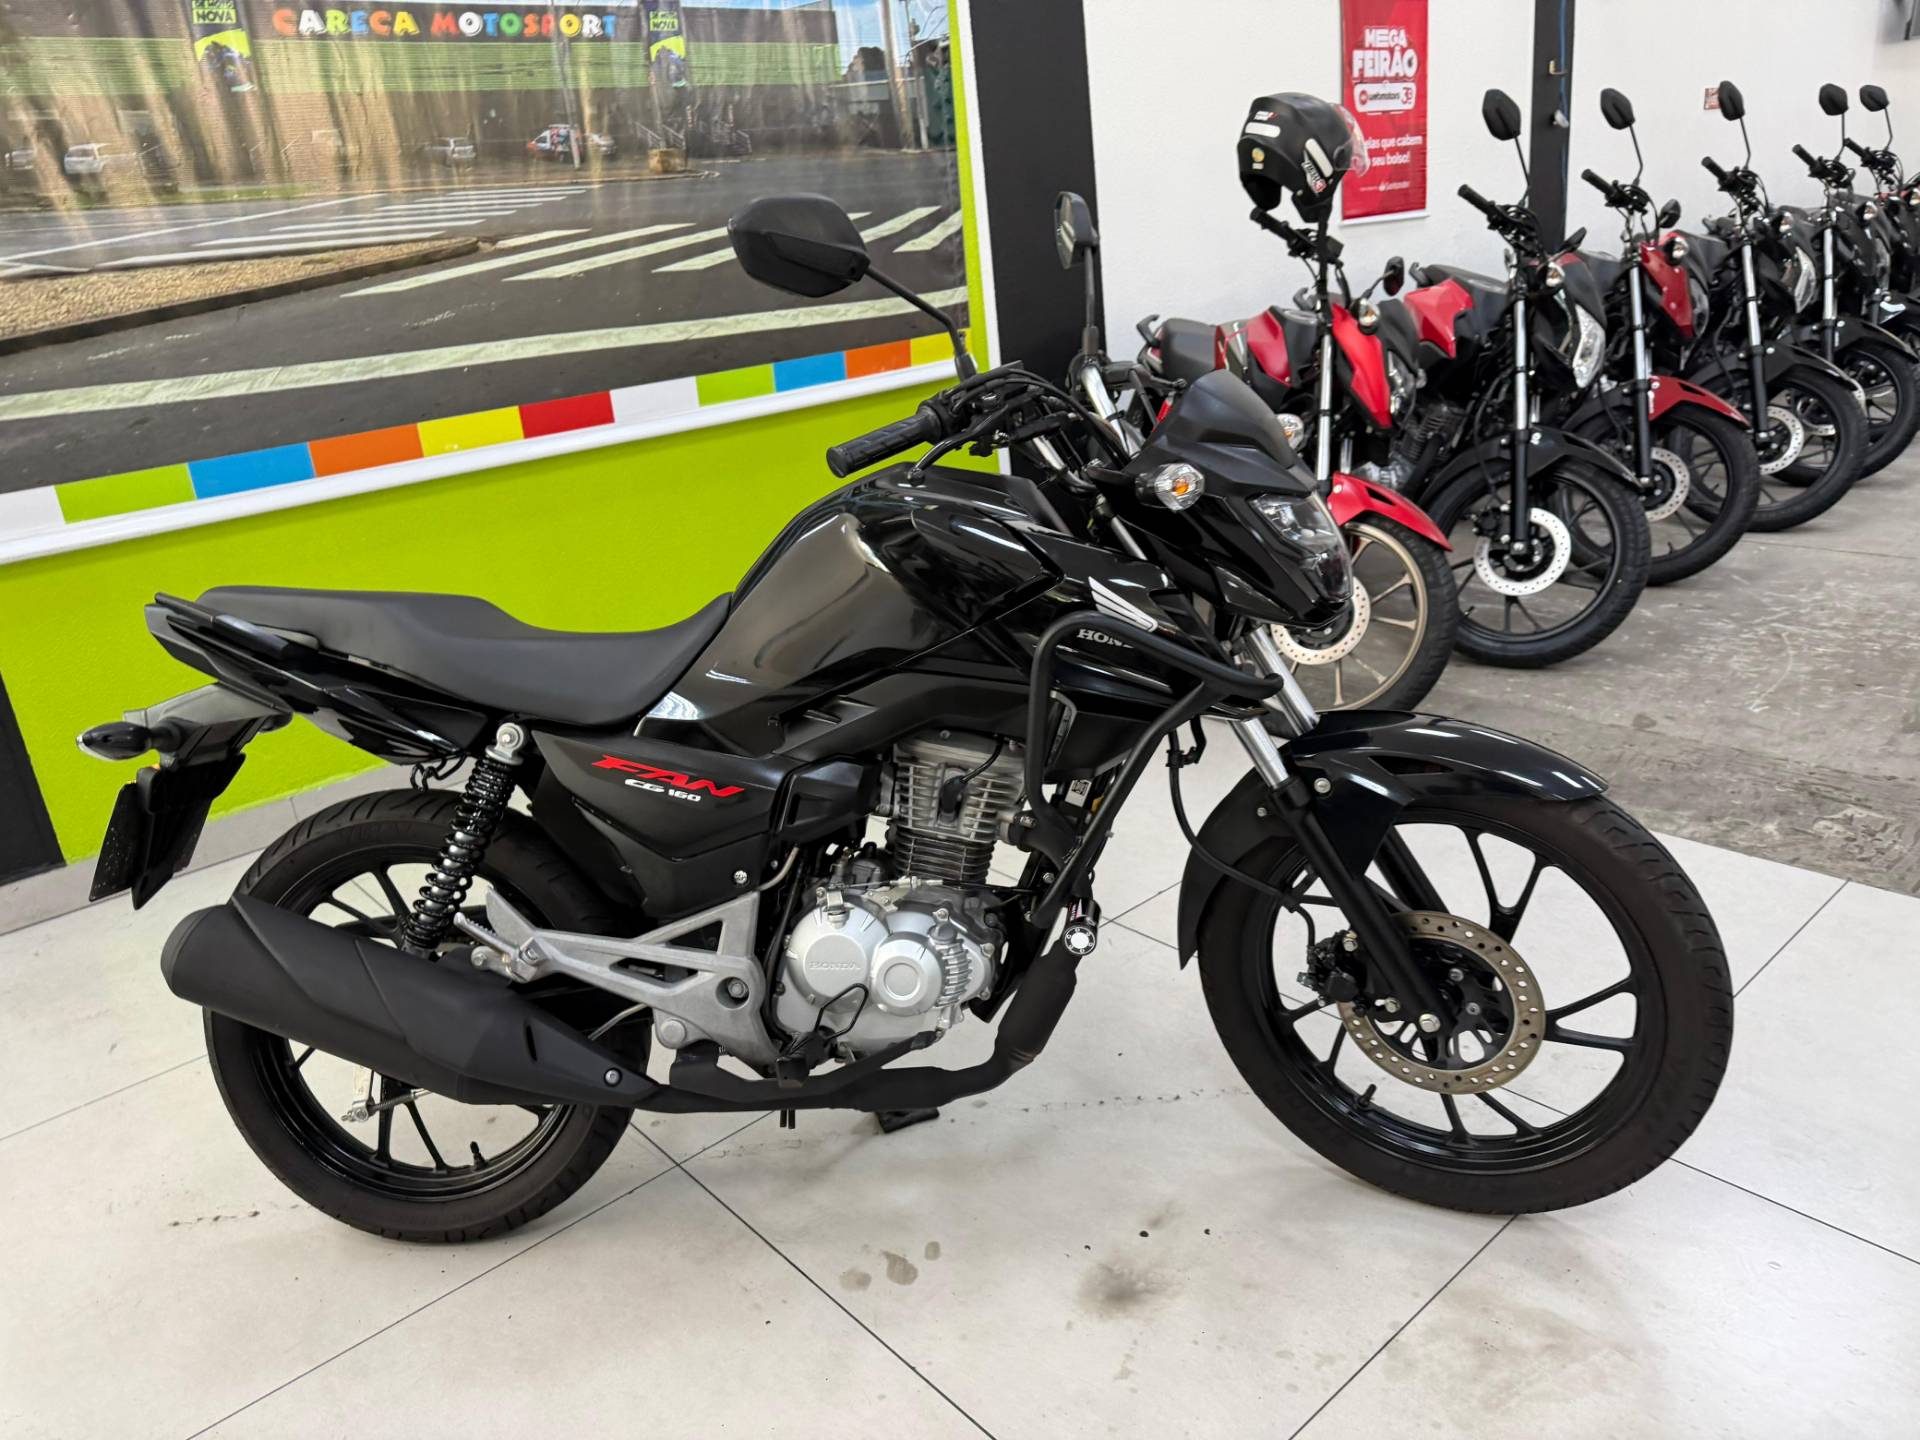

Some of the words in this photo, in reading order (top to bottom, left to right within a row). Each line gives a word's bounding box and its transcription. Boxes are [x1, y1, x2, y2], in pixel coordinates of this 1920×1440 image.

[195, 10, 233, 22] NOVA
[272, 9, 420, 37] CARECA
[430, 11, 616, 38] MOTOSPORT
[1364, 28, 1408, 48] MEGA
[1352, 45, 1418, 78] FEIRÃO
[1077, 628, 1134, 648] HON
[591, 754, 745, 797] FAN
[624, 778, 665, 793] CG
[668, 789, 702, 802] 160
[809, 960, 861, 970] HONDA
